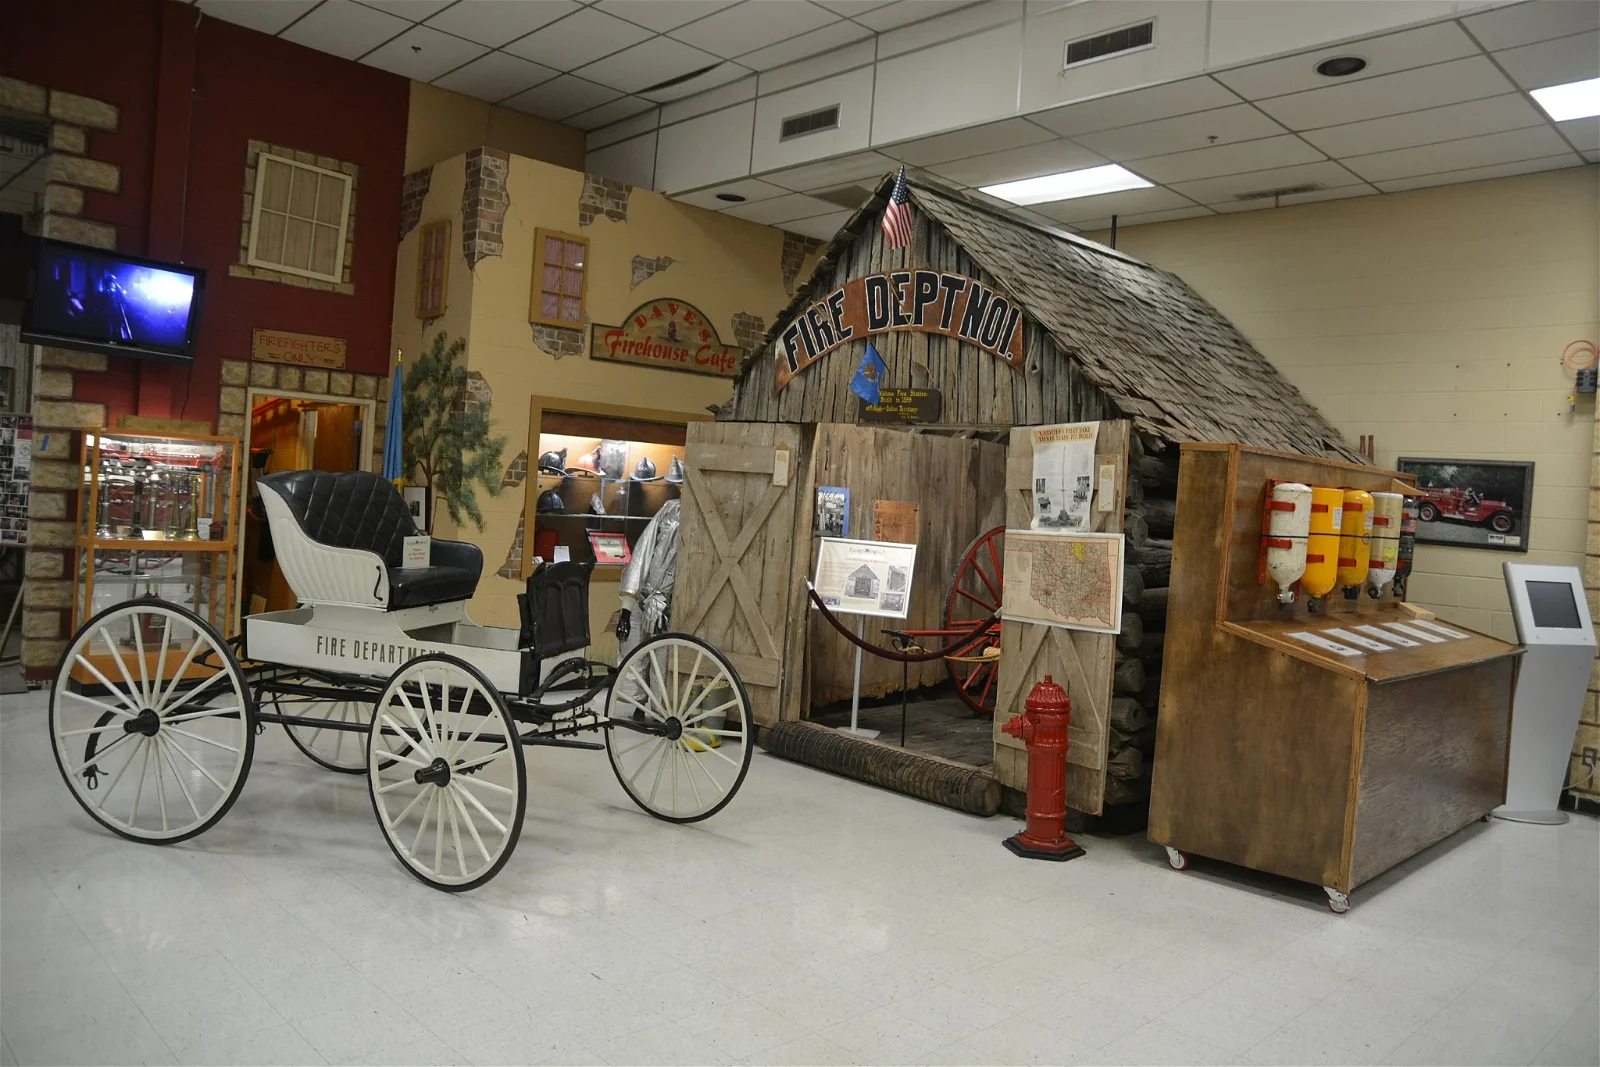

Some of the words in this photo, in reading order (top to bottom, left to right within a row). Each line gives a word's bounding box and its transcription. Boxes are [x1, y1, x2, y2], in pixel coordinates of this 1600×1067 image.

[633, 302, 711, 342] DAVE'S
[782, 288, 853, 375] FIRE
[865, 271, 966, 331] DEPT
[259, 335, 341, 354] FIREFIGHTERS
[283, 351, 318, 364] ONLY
[604, 330, 689, 363] Firehouse
[695, 344, 737, 373] Cafe
[316, 635, 346, 658] FIRE
